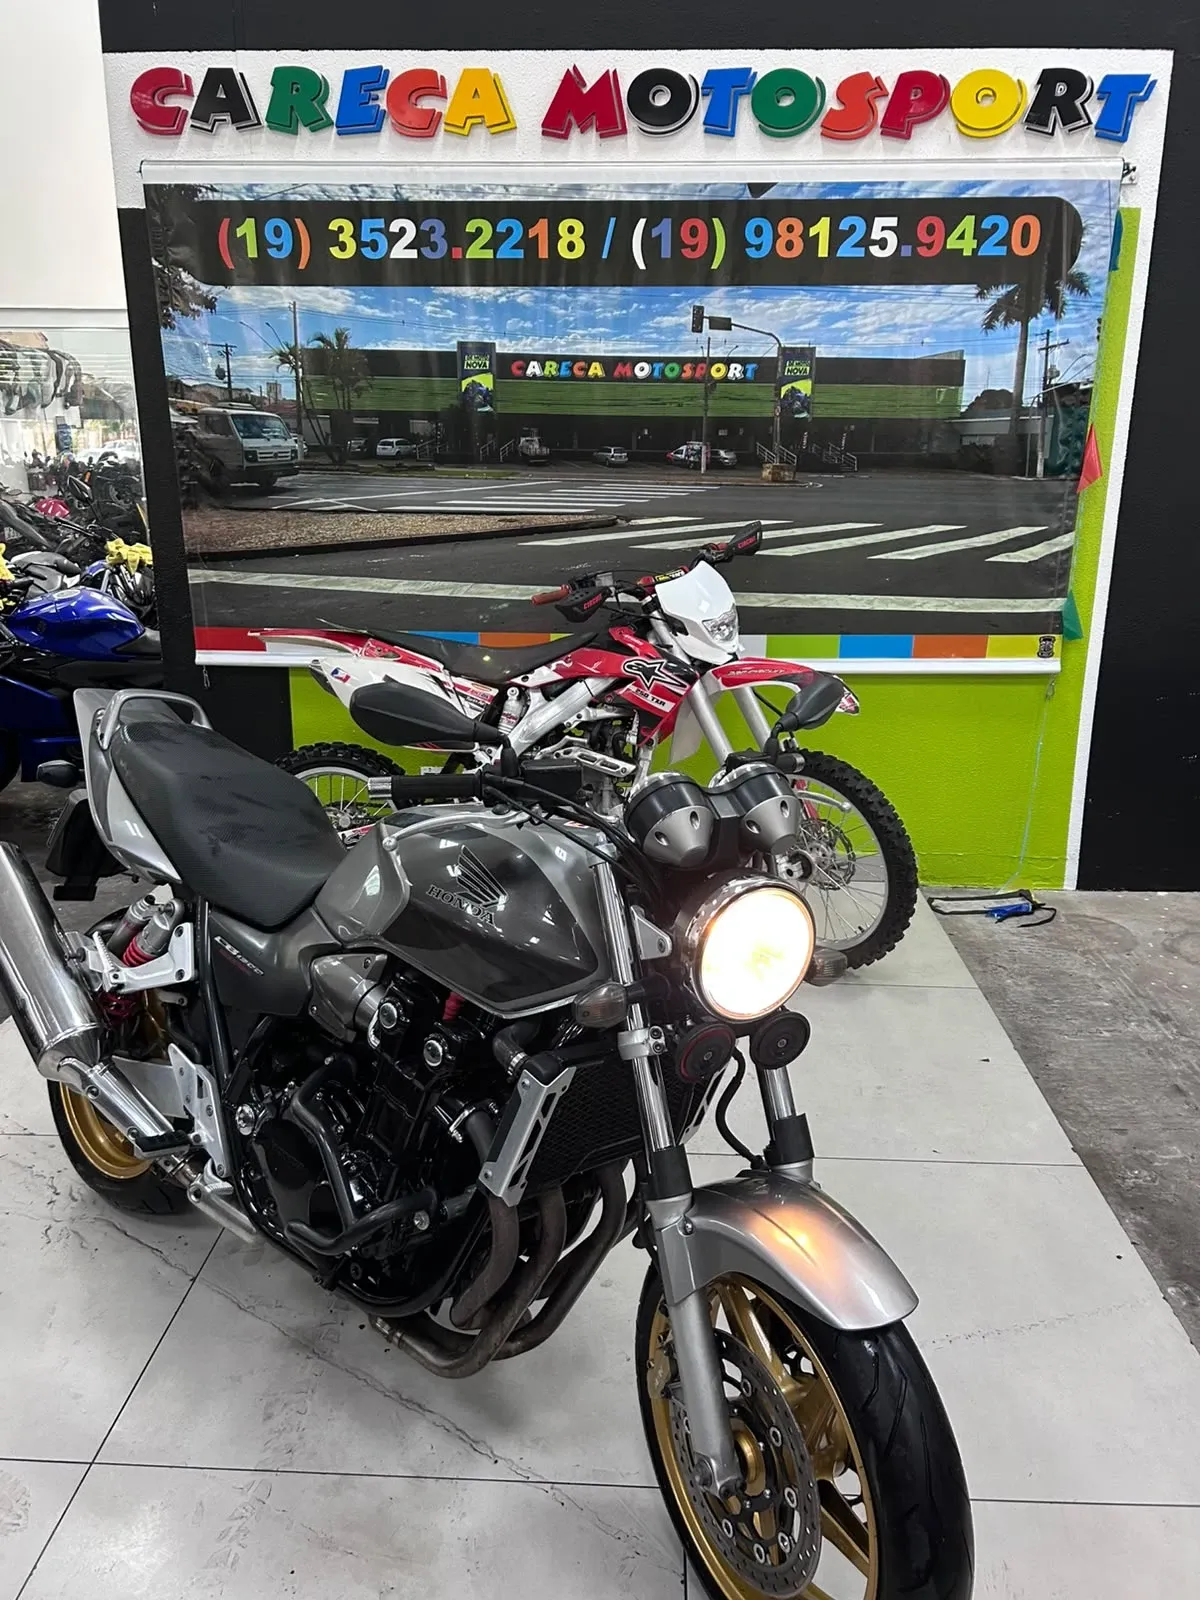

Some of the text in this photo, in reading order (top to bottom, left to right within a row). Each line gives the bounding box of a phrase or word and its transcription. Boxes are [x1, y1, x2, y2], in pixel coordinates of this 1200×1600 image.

[130, 64, 1157, 143] CARECA MOTOSPORT
[218, 217, 311, 270] (19)
[328, 217, 586, 260] 3523.2218
[632, 217, 727, 270] (19)
[744, 214, 1042, 259] 98125.9420
[465, 361, 488, 369] NOVA
[511, 360, 758, 380] CARECA MOTOSPORT
[786, 367, 808, 375] NOVA
[426, 884, 495, 927] HONDA
